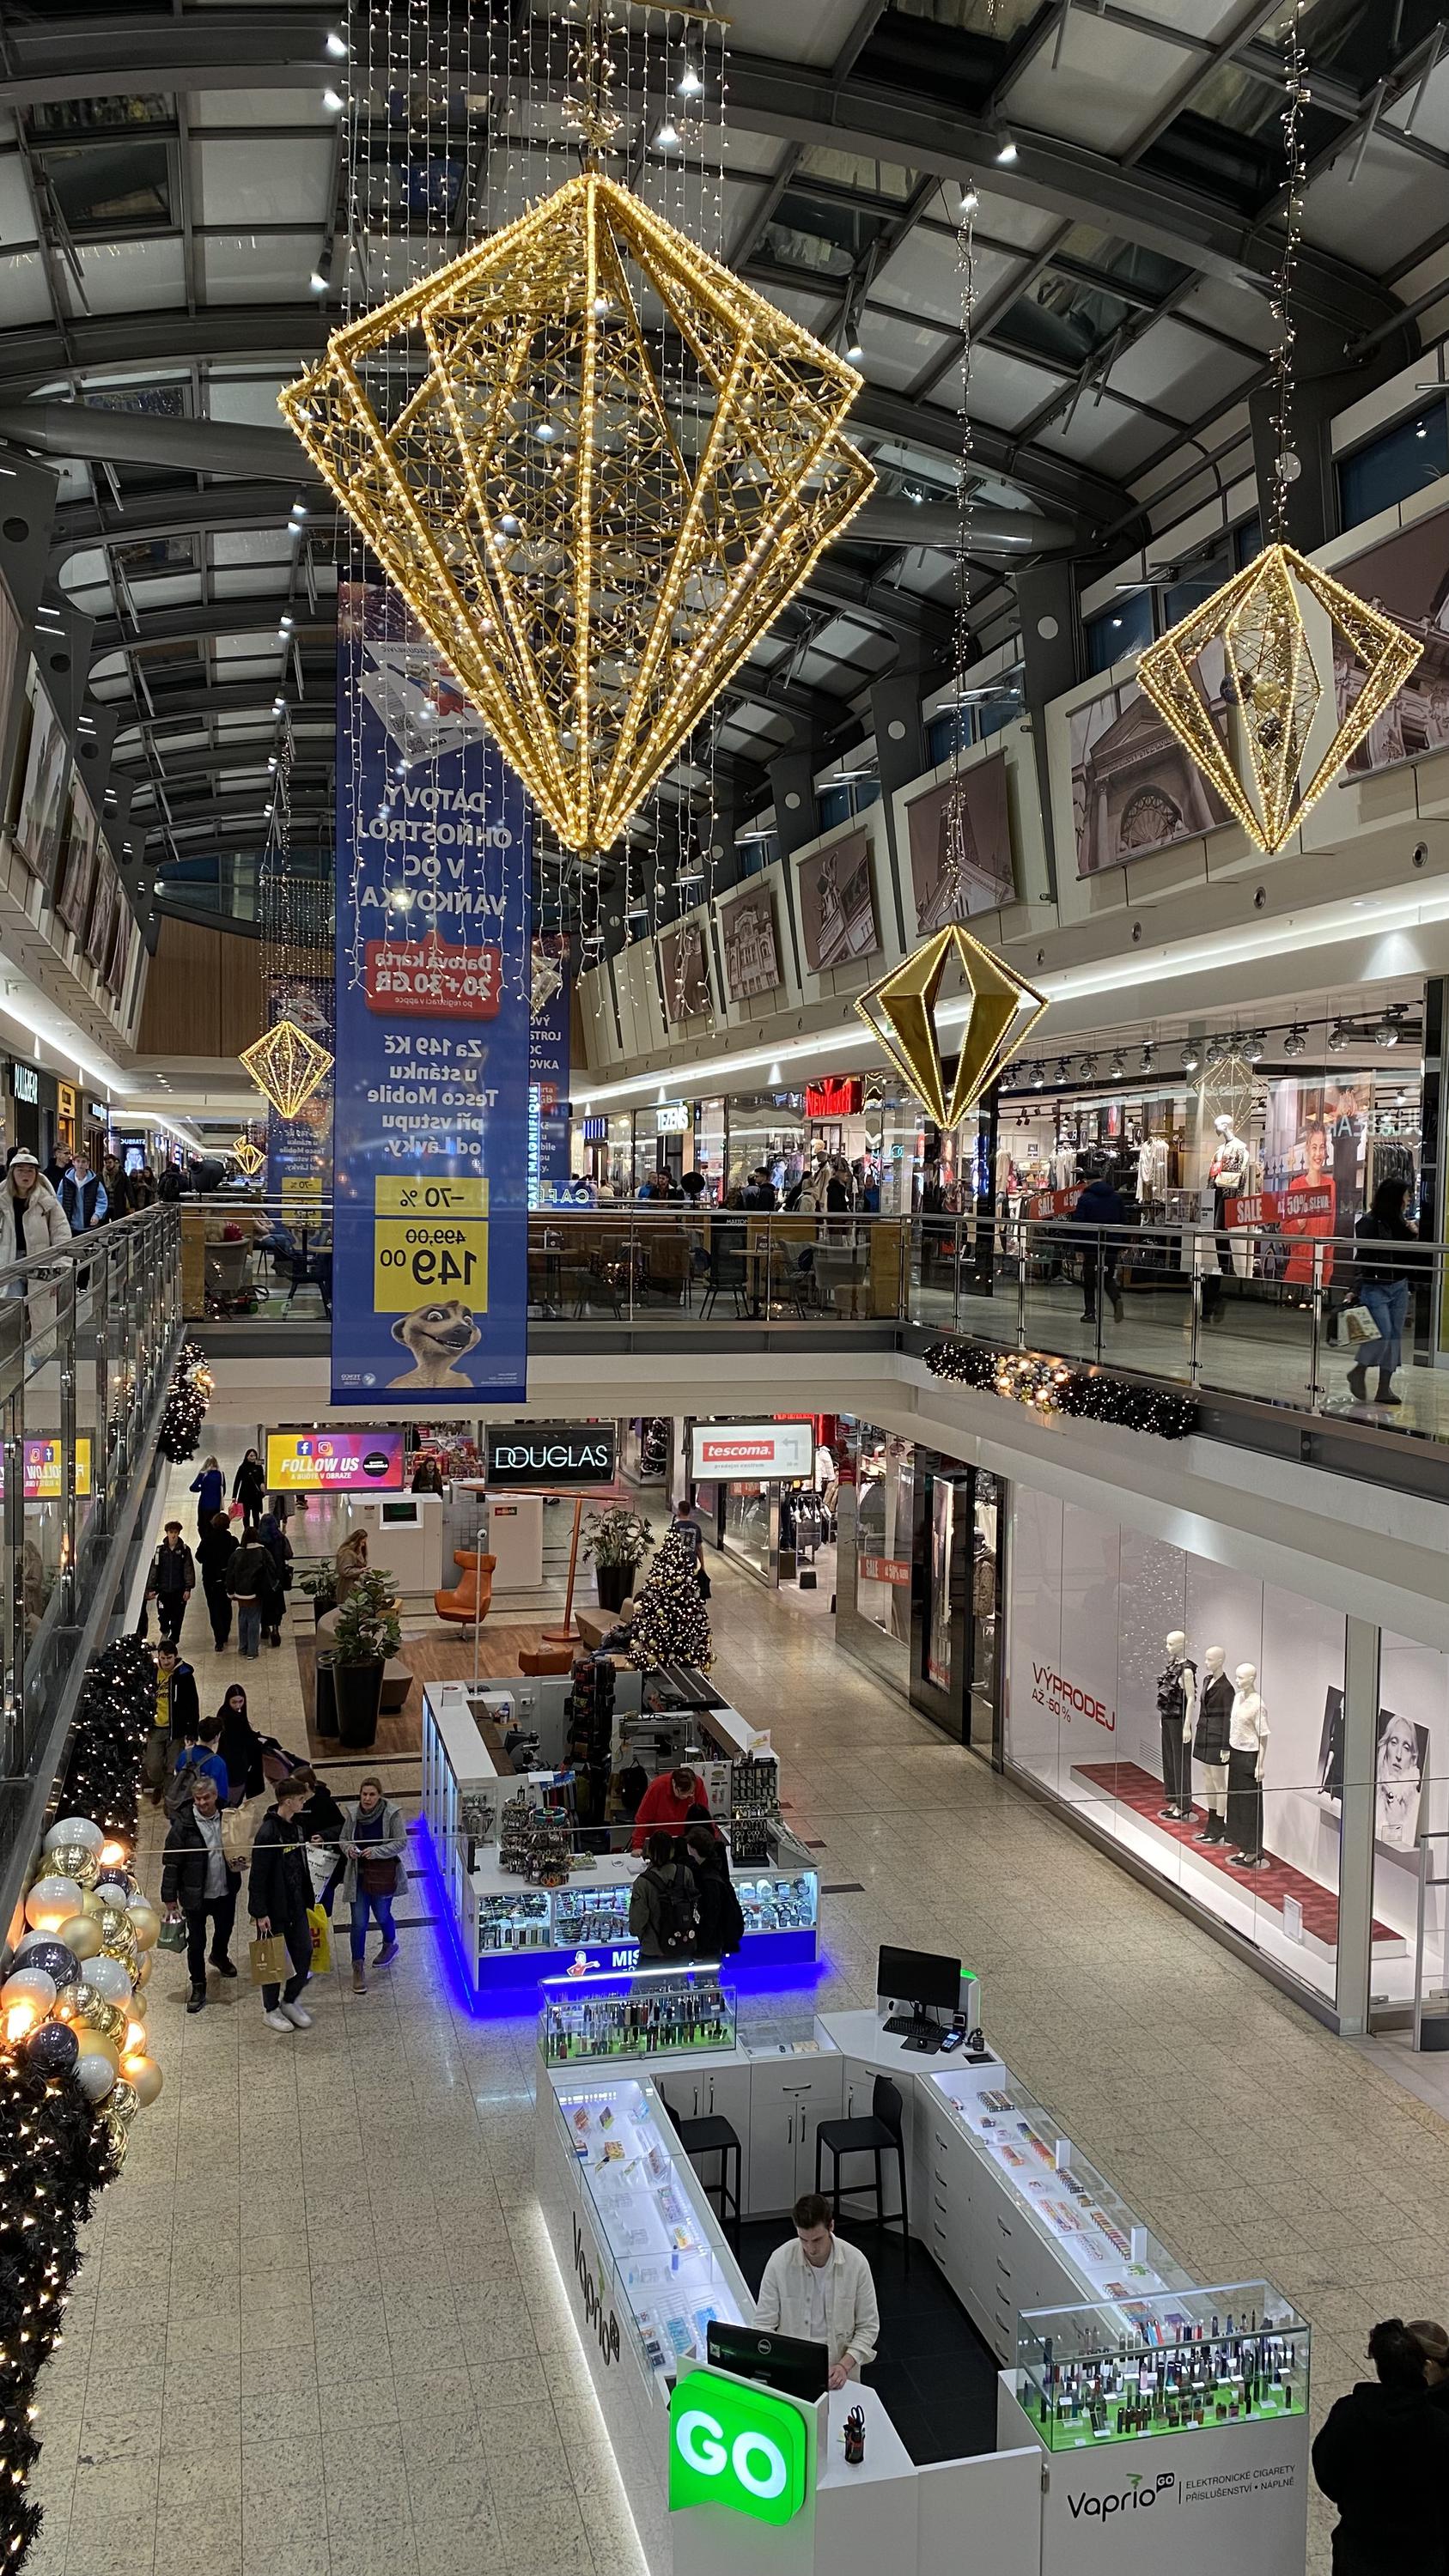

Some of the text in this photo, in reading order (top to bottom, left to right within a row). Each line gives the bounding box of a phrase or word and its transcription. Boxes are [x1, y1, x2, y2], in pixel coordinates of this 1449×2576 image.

[1038, 1195, 1055, 1216] SALE
[1237, 1198, 1263, 1224] SALE
[1288, 1194, 1308, 1214] 50%
[1310, 1194, 1330, 1210] SLEVA
[281, 1458, 338, 1473] FOLLOW
[340, 1457, 360, 1471] US
[496, 1445, 607, 1468] DOUGLAS
[1032, 1662, 1115, 1731] VÝPRODEJ
[1032, 1688, 1044, 1705] AŽ
[675, 2409, 787, 2500] GO
[1253, 2464, 1295, 2479] CIGARETY
[1068, 2475, 1173, 2522] Vaprio GO
